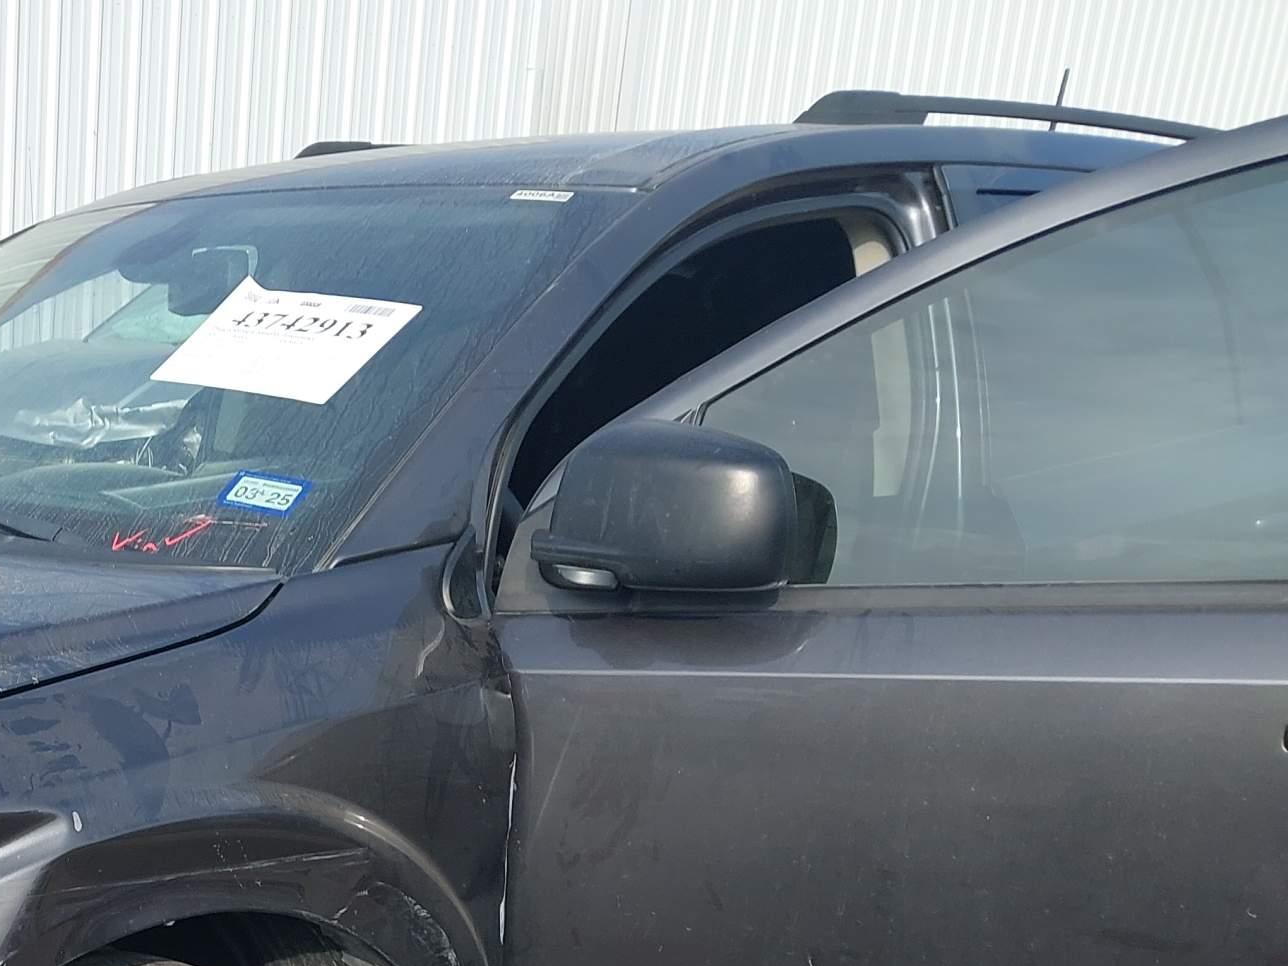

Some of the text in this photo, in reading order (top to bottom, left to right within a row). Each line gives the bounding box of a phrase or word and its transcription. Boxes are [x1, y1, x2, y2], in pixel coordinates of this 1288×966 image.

[232, 311, 374, 340] 43742913
[234, 485, 259, 501] 03
[264, 491, 294, 506] 25
